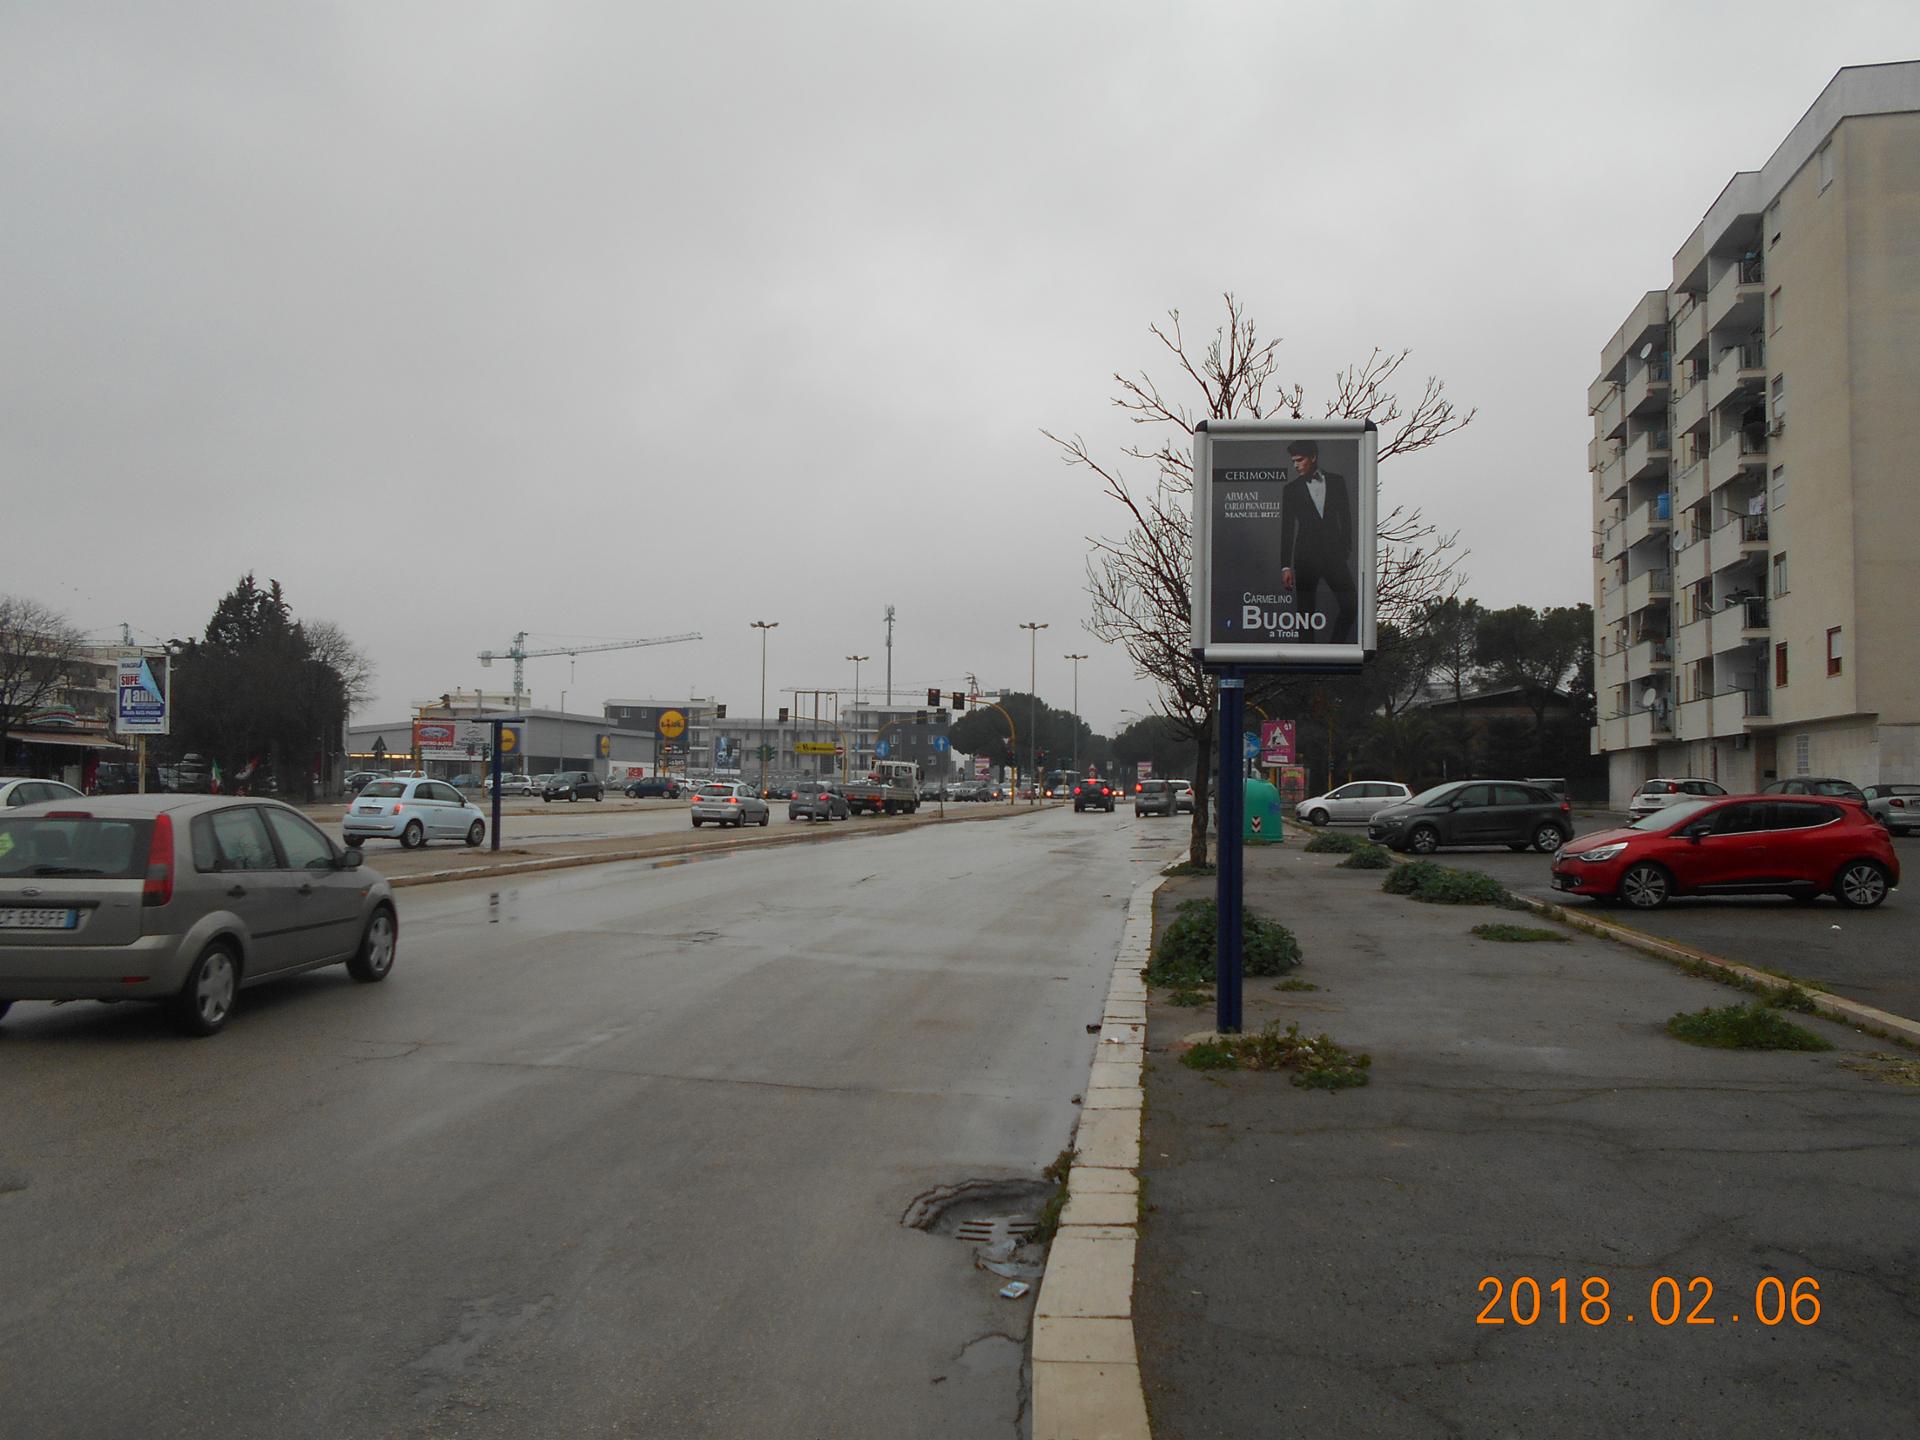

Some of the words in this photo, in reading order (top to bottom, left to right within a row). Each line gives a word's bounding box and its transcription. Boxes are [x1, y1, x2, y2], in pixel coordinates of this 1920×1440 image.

[1225, 471, 1287, 480] CERIMONIA
[1225, 491, 1259, 501] ARMANI
[1224, 502, 1245, 510] CARLO
[1242, 592, 1293, 604] CARMELINO
[1242, 605, 1327, 630] BUONO
[1277, 629, 1299, 638] Troia
[122, 688, 133, 710] 4
